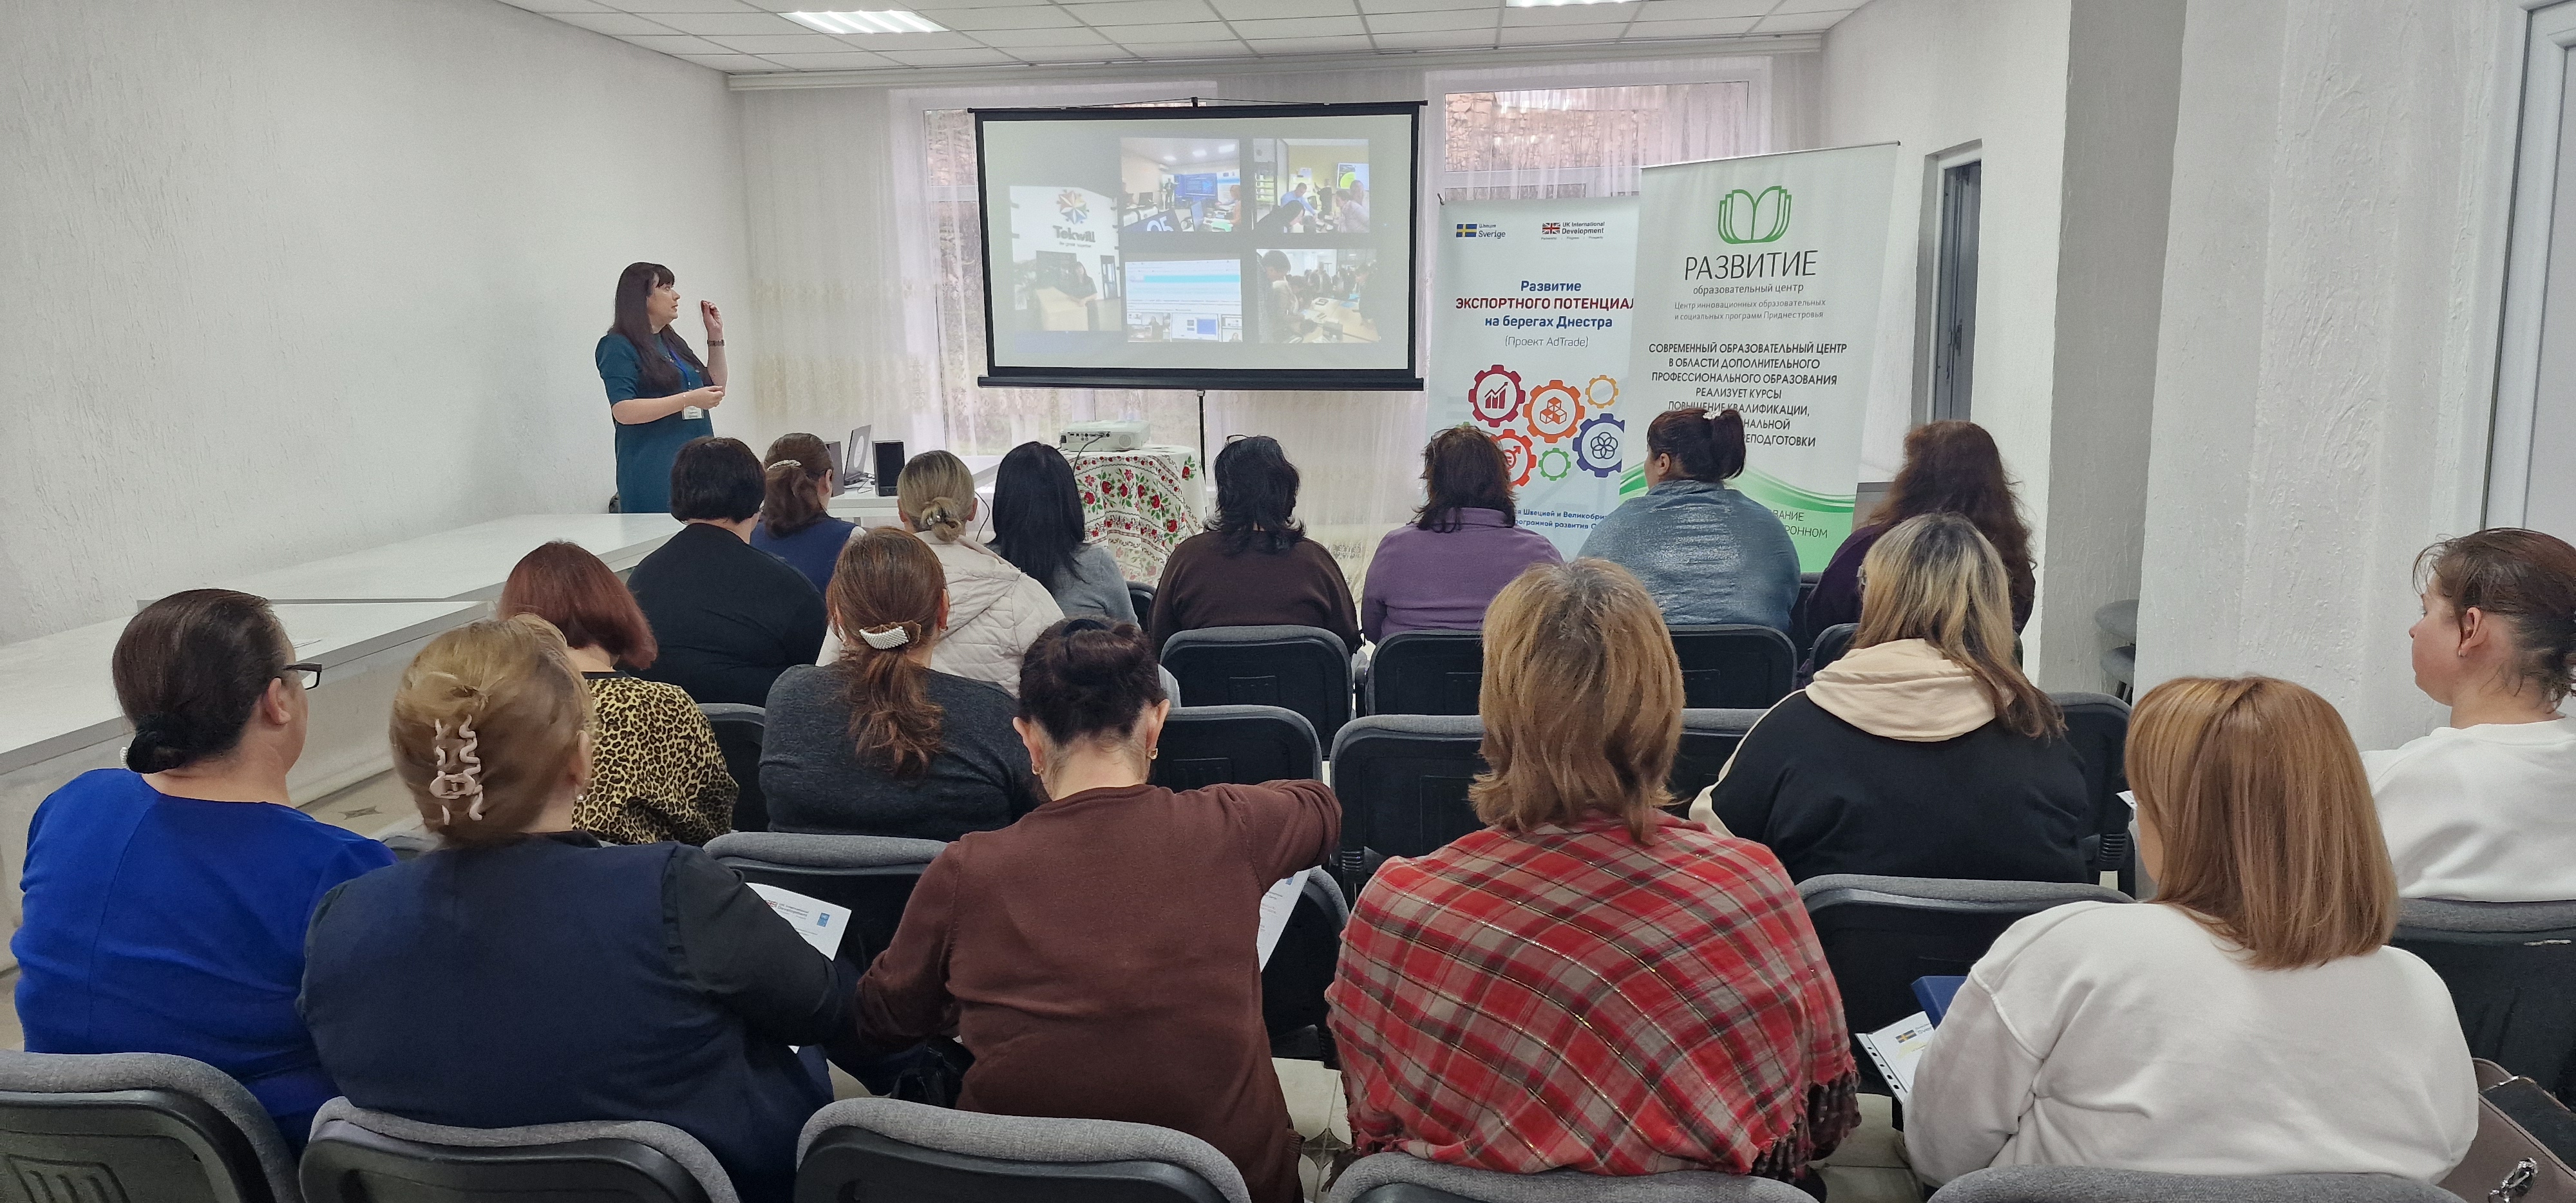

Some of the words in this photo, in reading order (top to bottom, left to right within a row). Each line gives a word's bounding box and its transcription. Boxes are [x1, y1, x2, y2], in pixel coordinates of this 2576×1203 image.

[1479, 231, 1506, 239] Sverige
[1685, 250, 1818, 280] РАЗВИТИЕ
[1520, 280, 1582, 292] Развитие
[1693, 284, 1773, 296] образовательный
[1775, 284, 1804, 294] центр
[1455, 298, 1551, 310] ЭКСПОРТНОГО
[1674, 301, 1696, 310] Центр
[1697, 300, 1757, 309] инновационных
[1758, 298, 1826, 308] образовательных
[1763, 310, 1824, 319] Приднестровья
[1485, 317, 1499, 327] на
[1502, 315, 1553, 329] берегах
[1556, 316, 1613, 330] Днестра
[1505, 335, 1544, 348] (Проект
[1546, 336, 1589, 348] AdTrade)
[1649, 342, 1717, 354] СОВРЕМЕННЫЙ
[1719, 341, 1814, 354] ОБРАЗОВАТЕЛЬНЫЙ
[1815, 343, 1848, 355] ЦЕНТР
[1669, 358, 1674, 367] В
[1675, 358, 1719, 368] ОБЛАСТИ
[1720, 359, 1821, 369] ДОПОЛНИТЕЛЬНОГО
[1651, 372, 1761, 383] ПРОФЕССИОНАЛЬНОГО
[1763, 374, 1837, 385] ОБРАЗОВАНИЯ
[1696, 388, 1747, 398] РЕАЛИЗУЕТ
[1749, 389, 1782, 399] КУРСЫ
[1743, 419, 1790, 430] НАЛЬНОЙ
[1524, 509, 1555, 517] Швецией
[1563, 511, 1607, 522] Великобри
[1773, 509, 1804, 521] ВАНИЕ
[1515, 519, 1553, 527] рограммой
[1785, 526, 1828, 538] РОННОМ
